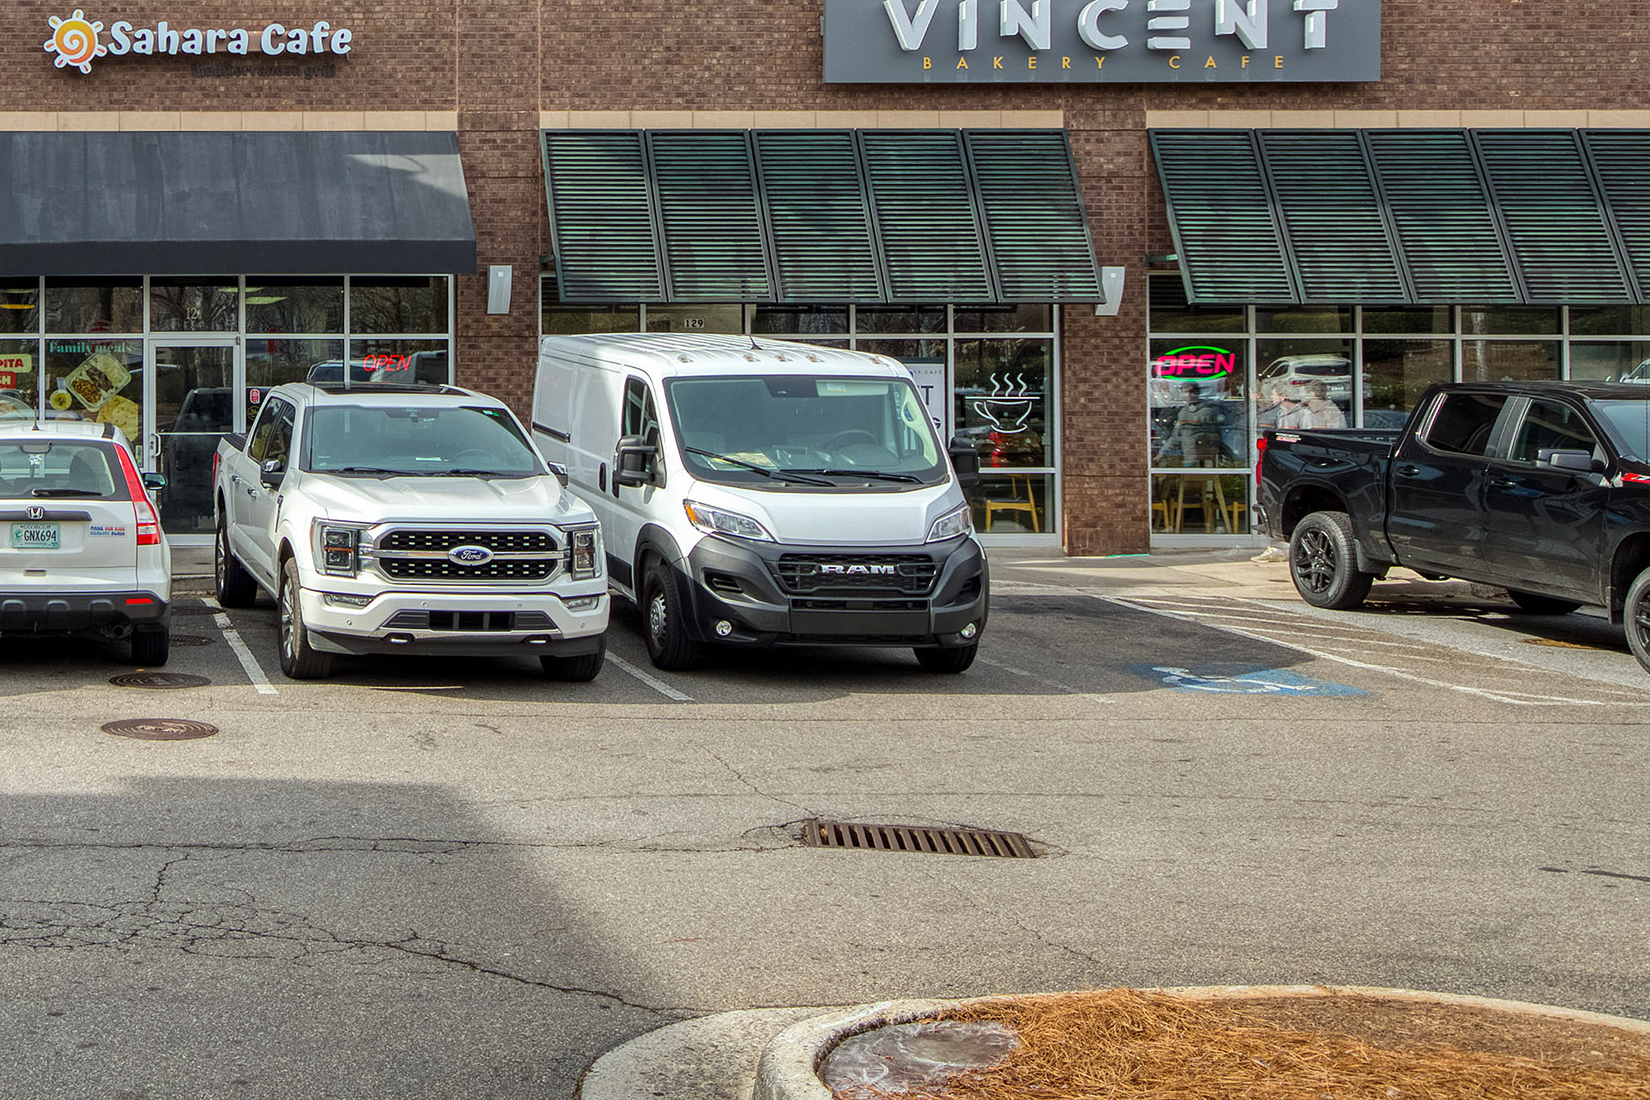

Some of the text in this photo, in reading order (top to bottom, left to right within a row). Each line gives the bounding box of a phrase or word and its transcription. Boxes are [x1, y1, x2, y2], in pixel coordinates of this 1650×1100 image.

[107, 20, 353, 56] Sahara Cafe
[922, 54, 1285, 71] BAKERY CAFE
[303, 63, 337, 80] grill
[684, 318, 705, 329] 129
[49, 342, 133, 355] Family meals
[363, 354, 412, 372] OPEN
[1154, 352, 1236, 376] OPEN
[23, 529, 58, 542] GNX694
[460, 550, 483, 560] Ford
[819, 564, 895, 575] RAM
